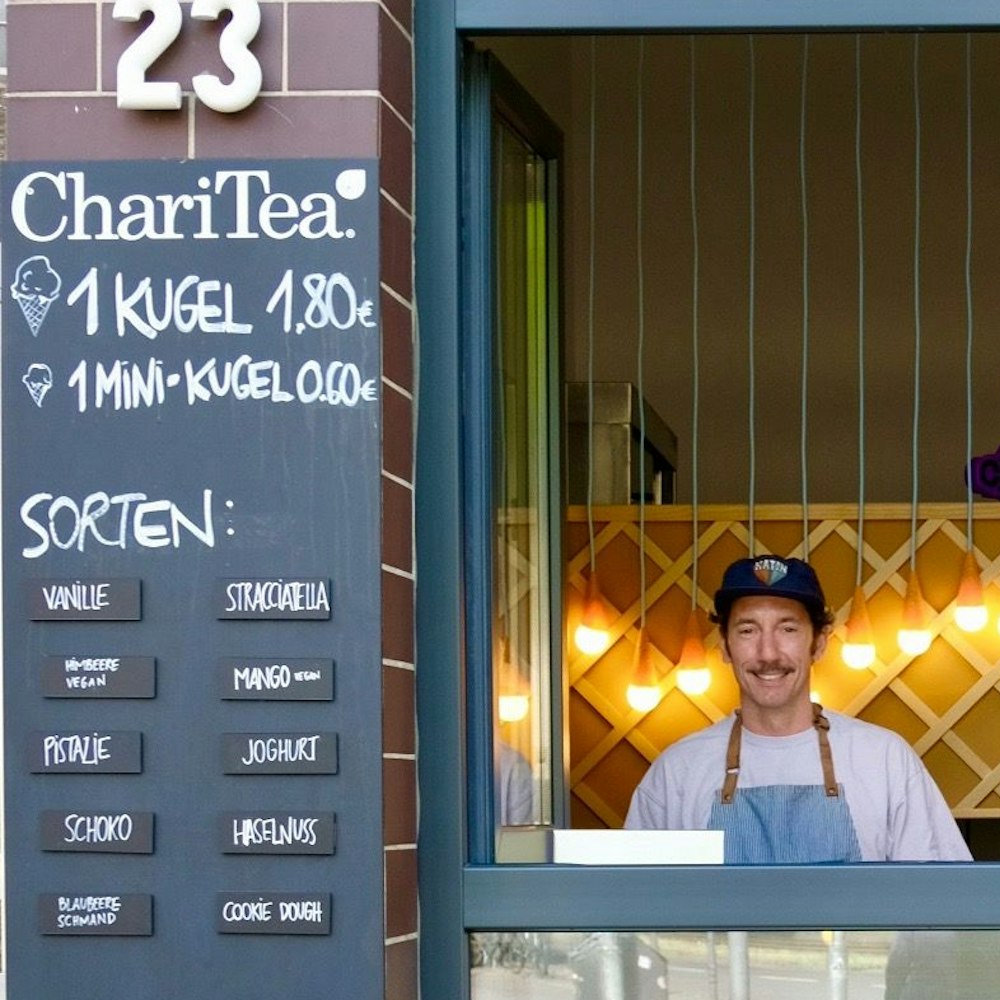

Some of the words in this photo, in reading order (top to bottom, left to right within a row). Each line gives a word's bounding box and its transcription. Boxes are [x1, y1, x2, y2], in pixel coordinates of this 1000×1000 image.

[112, 0, 263, 113] 23
[67, 267, 98, 336] 1
[116, 272, 253, 340] KUGEL
[68, 360, 87, 412] 1
[20, 489, 235, 559] SORTEN:
[42, 580, 111, 611] VANILLE
[225, 578, 331, 613] STRACCIATELLA
[65, 656, 121, 673] HIMBEERE
[233, 665, 291, 690] MANGO
[65, 673, 106, 689] VEGAN
[242, 734, 321, 765] JOGHURT
[64, 813, 132, 843] SCHOKO
[233, 816, 319, 846] HASELNUSS
[57, 896, 121, 912] BLAUBEERE
[222, 896, 272, 923] COOKIE
[279, 899, 323, 923] DOUGH
[57, 911, 117, 928] SCHMAND
